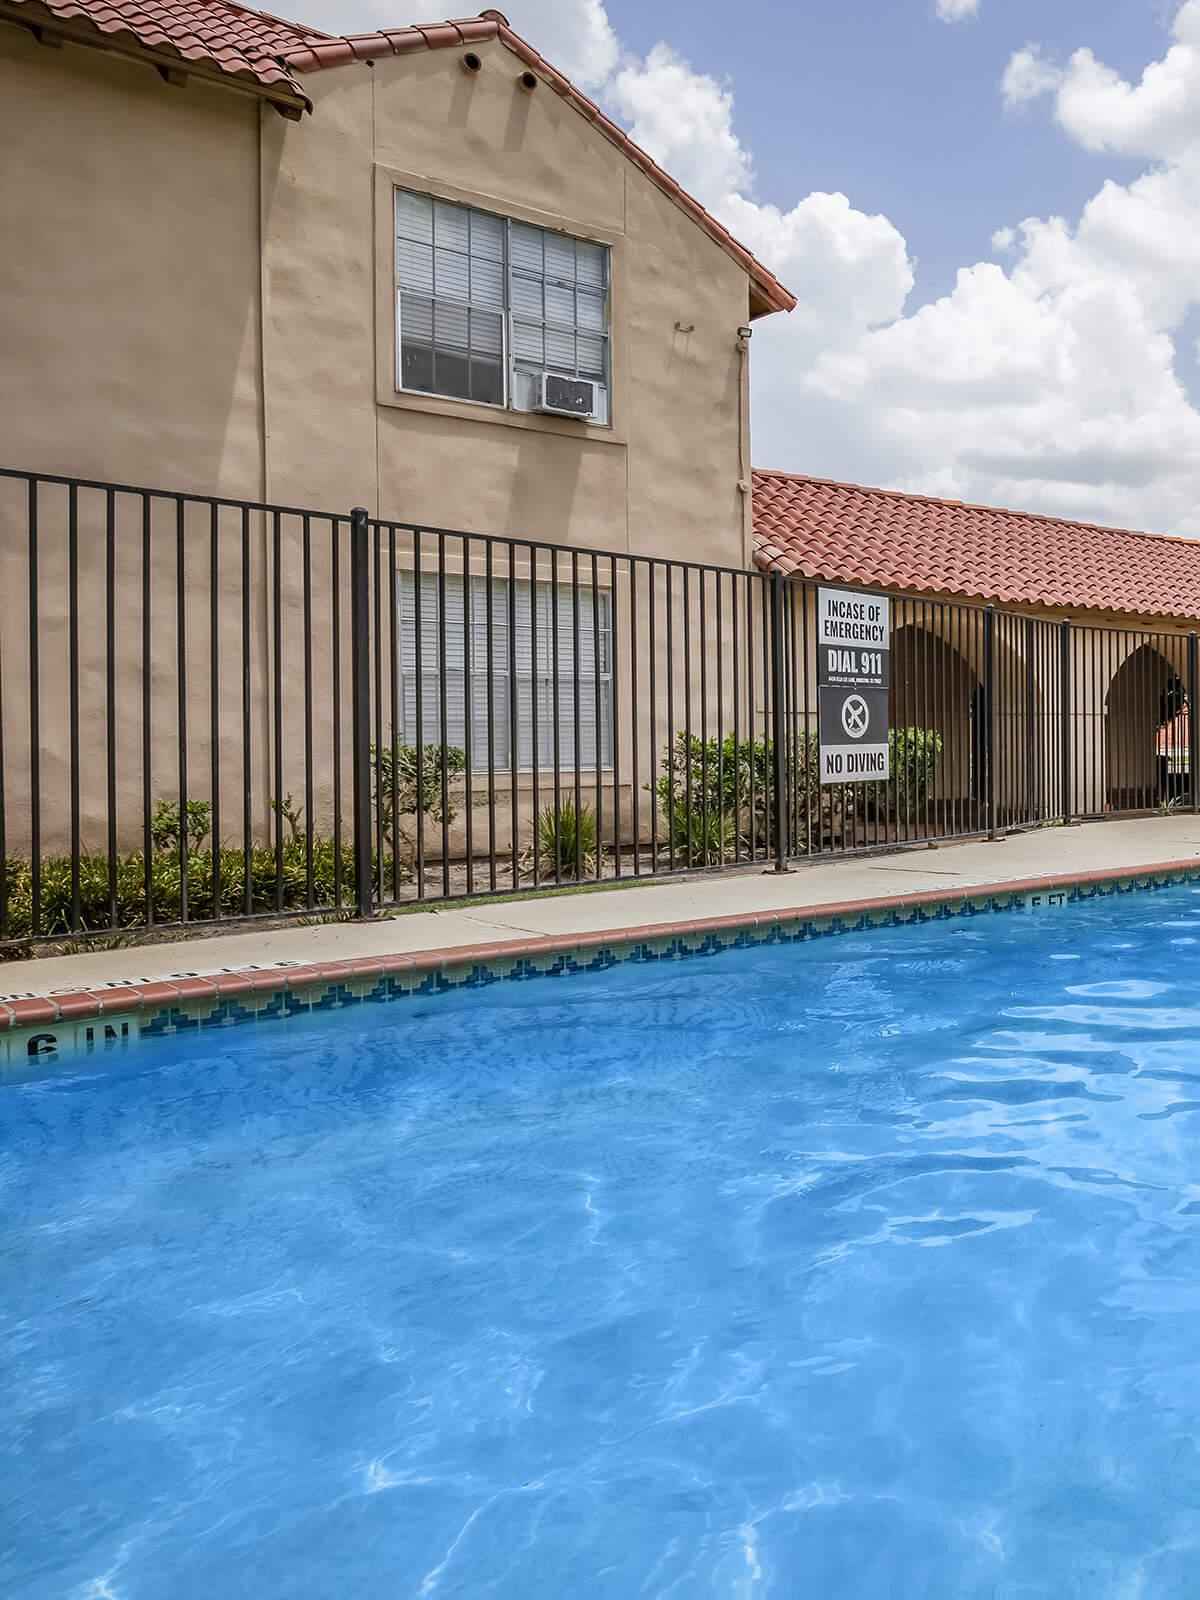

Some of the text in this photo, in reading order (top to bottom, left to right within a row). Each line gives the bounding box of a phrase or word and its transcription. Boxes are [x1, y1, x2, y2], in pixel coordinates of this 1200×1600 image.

[828, 599, 881, 622] INCASE OF
[824, 619, 885, 642] EMERGENCY
[828, 649, 882, 675] DIAL 911
[826, 752, 885, 774] NO DIVING
[1048, 892, 1065, 906] FT
[86, 1022, 129, 1045] IN
